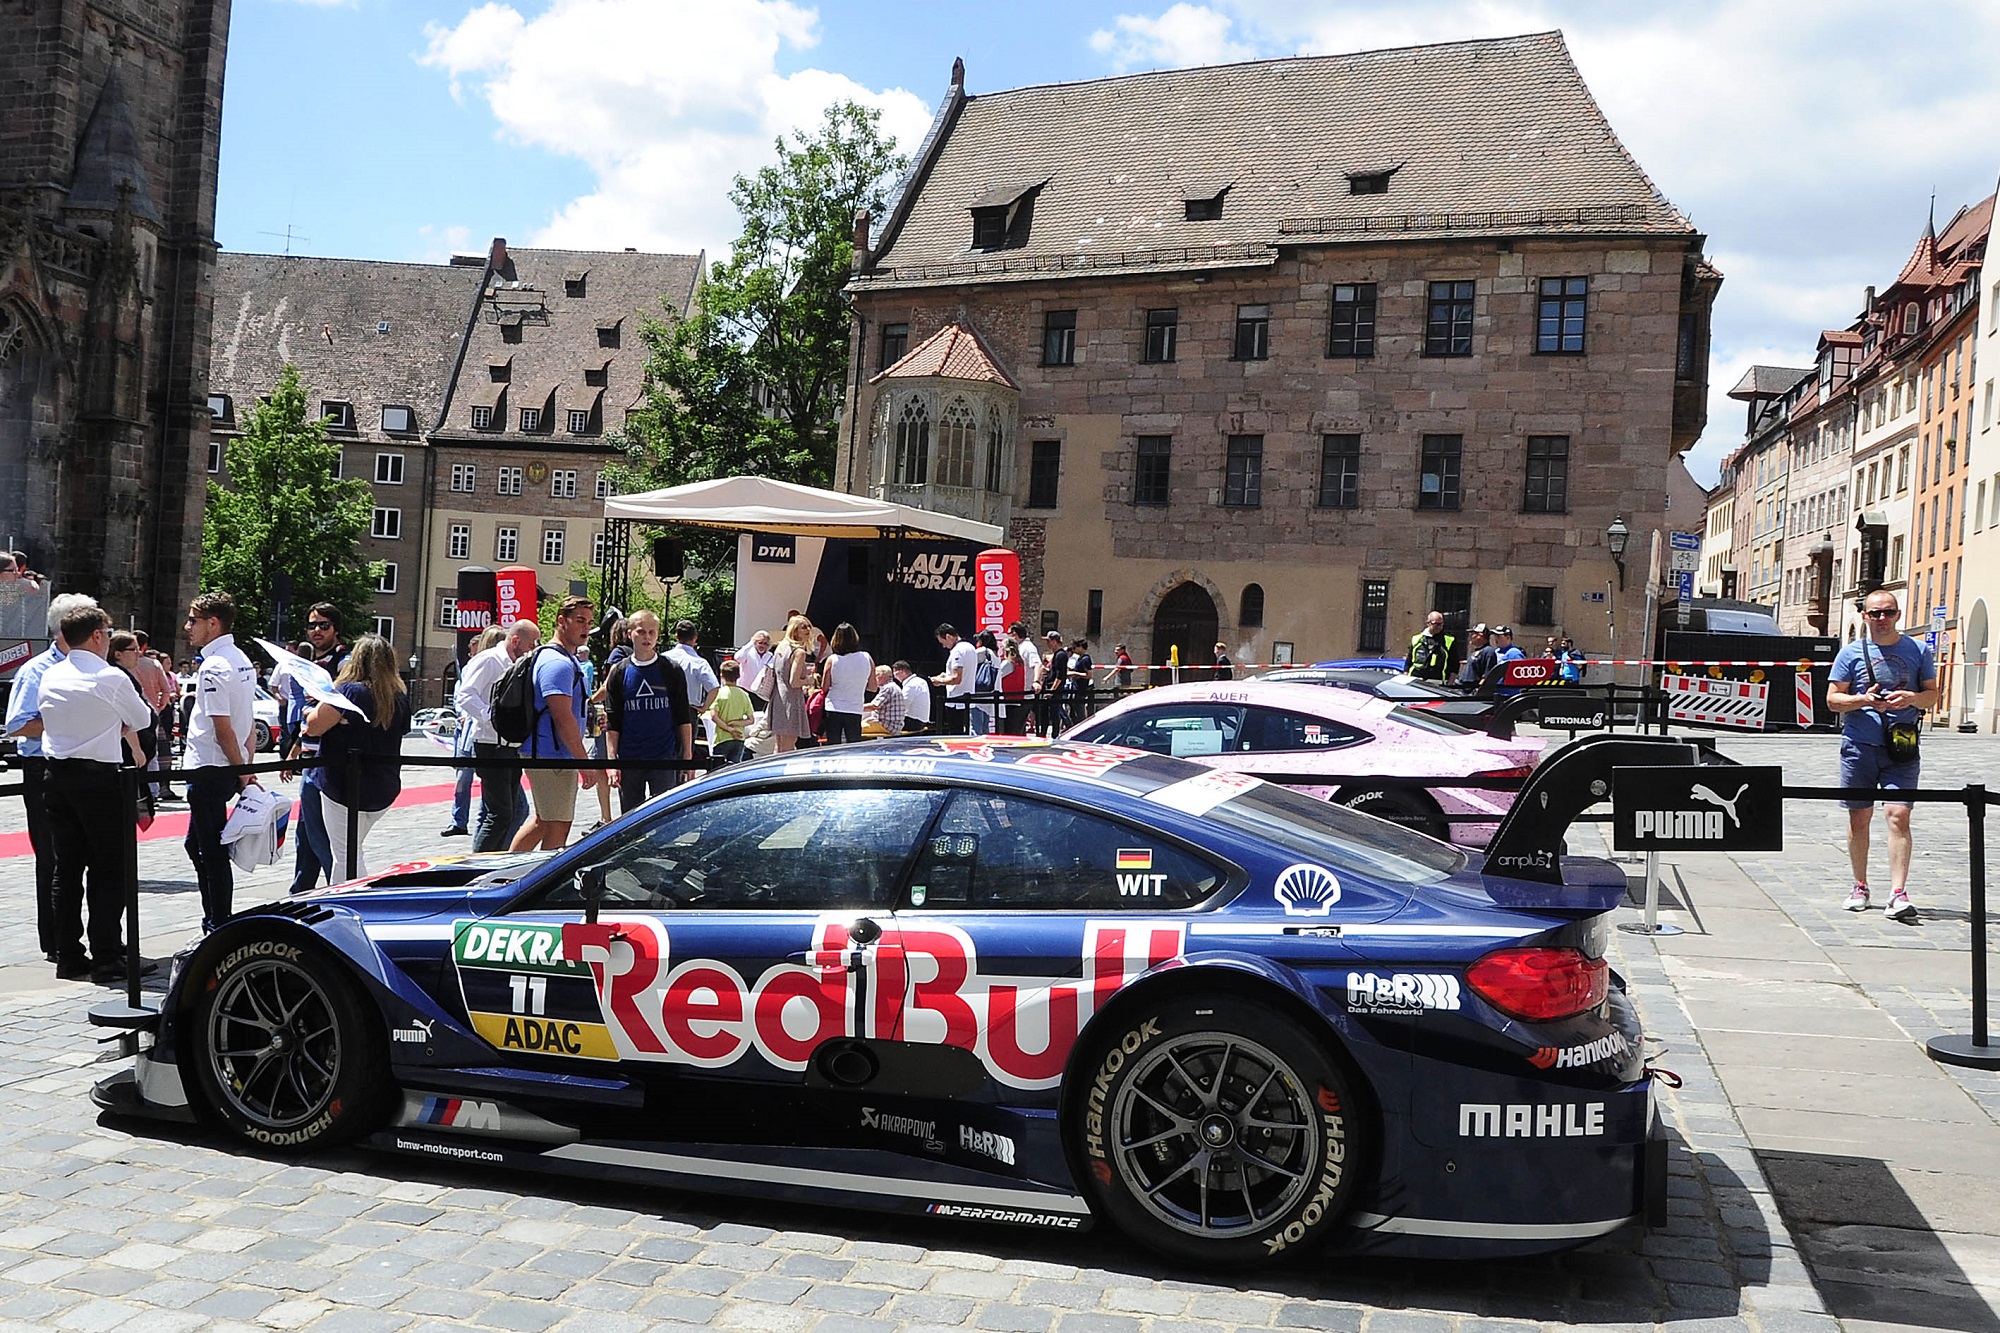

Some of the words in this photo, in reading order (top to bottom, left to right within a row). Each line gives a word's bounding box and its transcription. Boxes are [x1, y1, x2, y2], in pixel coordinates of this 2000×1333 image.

[757, 545, 791, 558] DTM
[914, 574, 977, 592] DRAN.
[645, 696, 670, 710] FLOYD
[1210, 692, 1248, 701] AUER
[1544, 716, 1592, 725] PETRONAS
[1305, 734, 1330, 744] AUE
[1635, 811, 1724, 839] PUMA
[1498, 853, 1546, 869] amplus
[1116, 874, 1168, 896] WIT
[509, 975, 547, 1015] 11
[563, 920, 852, 1066] Red
[1347, 972, 1423, 1008] H&R
[393, 1029, 426, 1042] PUMA
[503, 1018, 581, 1054] ADAC
[452, 1100, 500, 1130] M
[1459, 1102, 1604, 1137] MAHLE
[397, 1138, 503, 1162] bmw-motorsport.com
[959, 1124, 998, 1158] H&R
